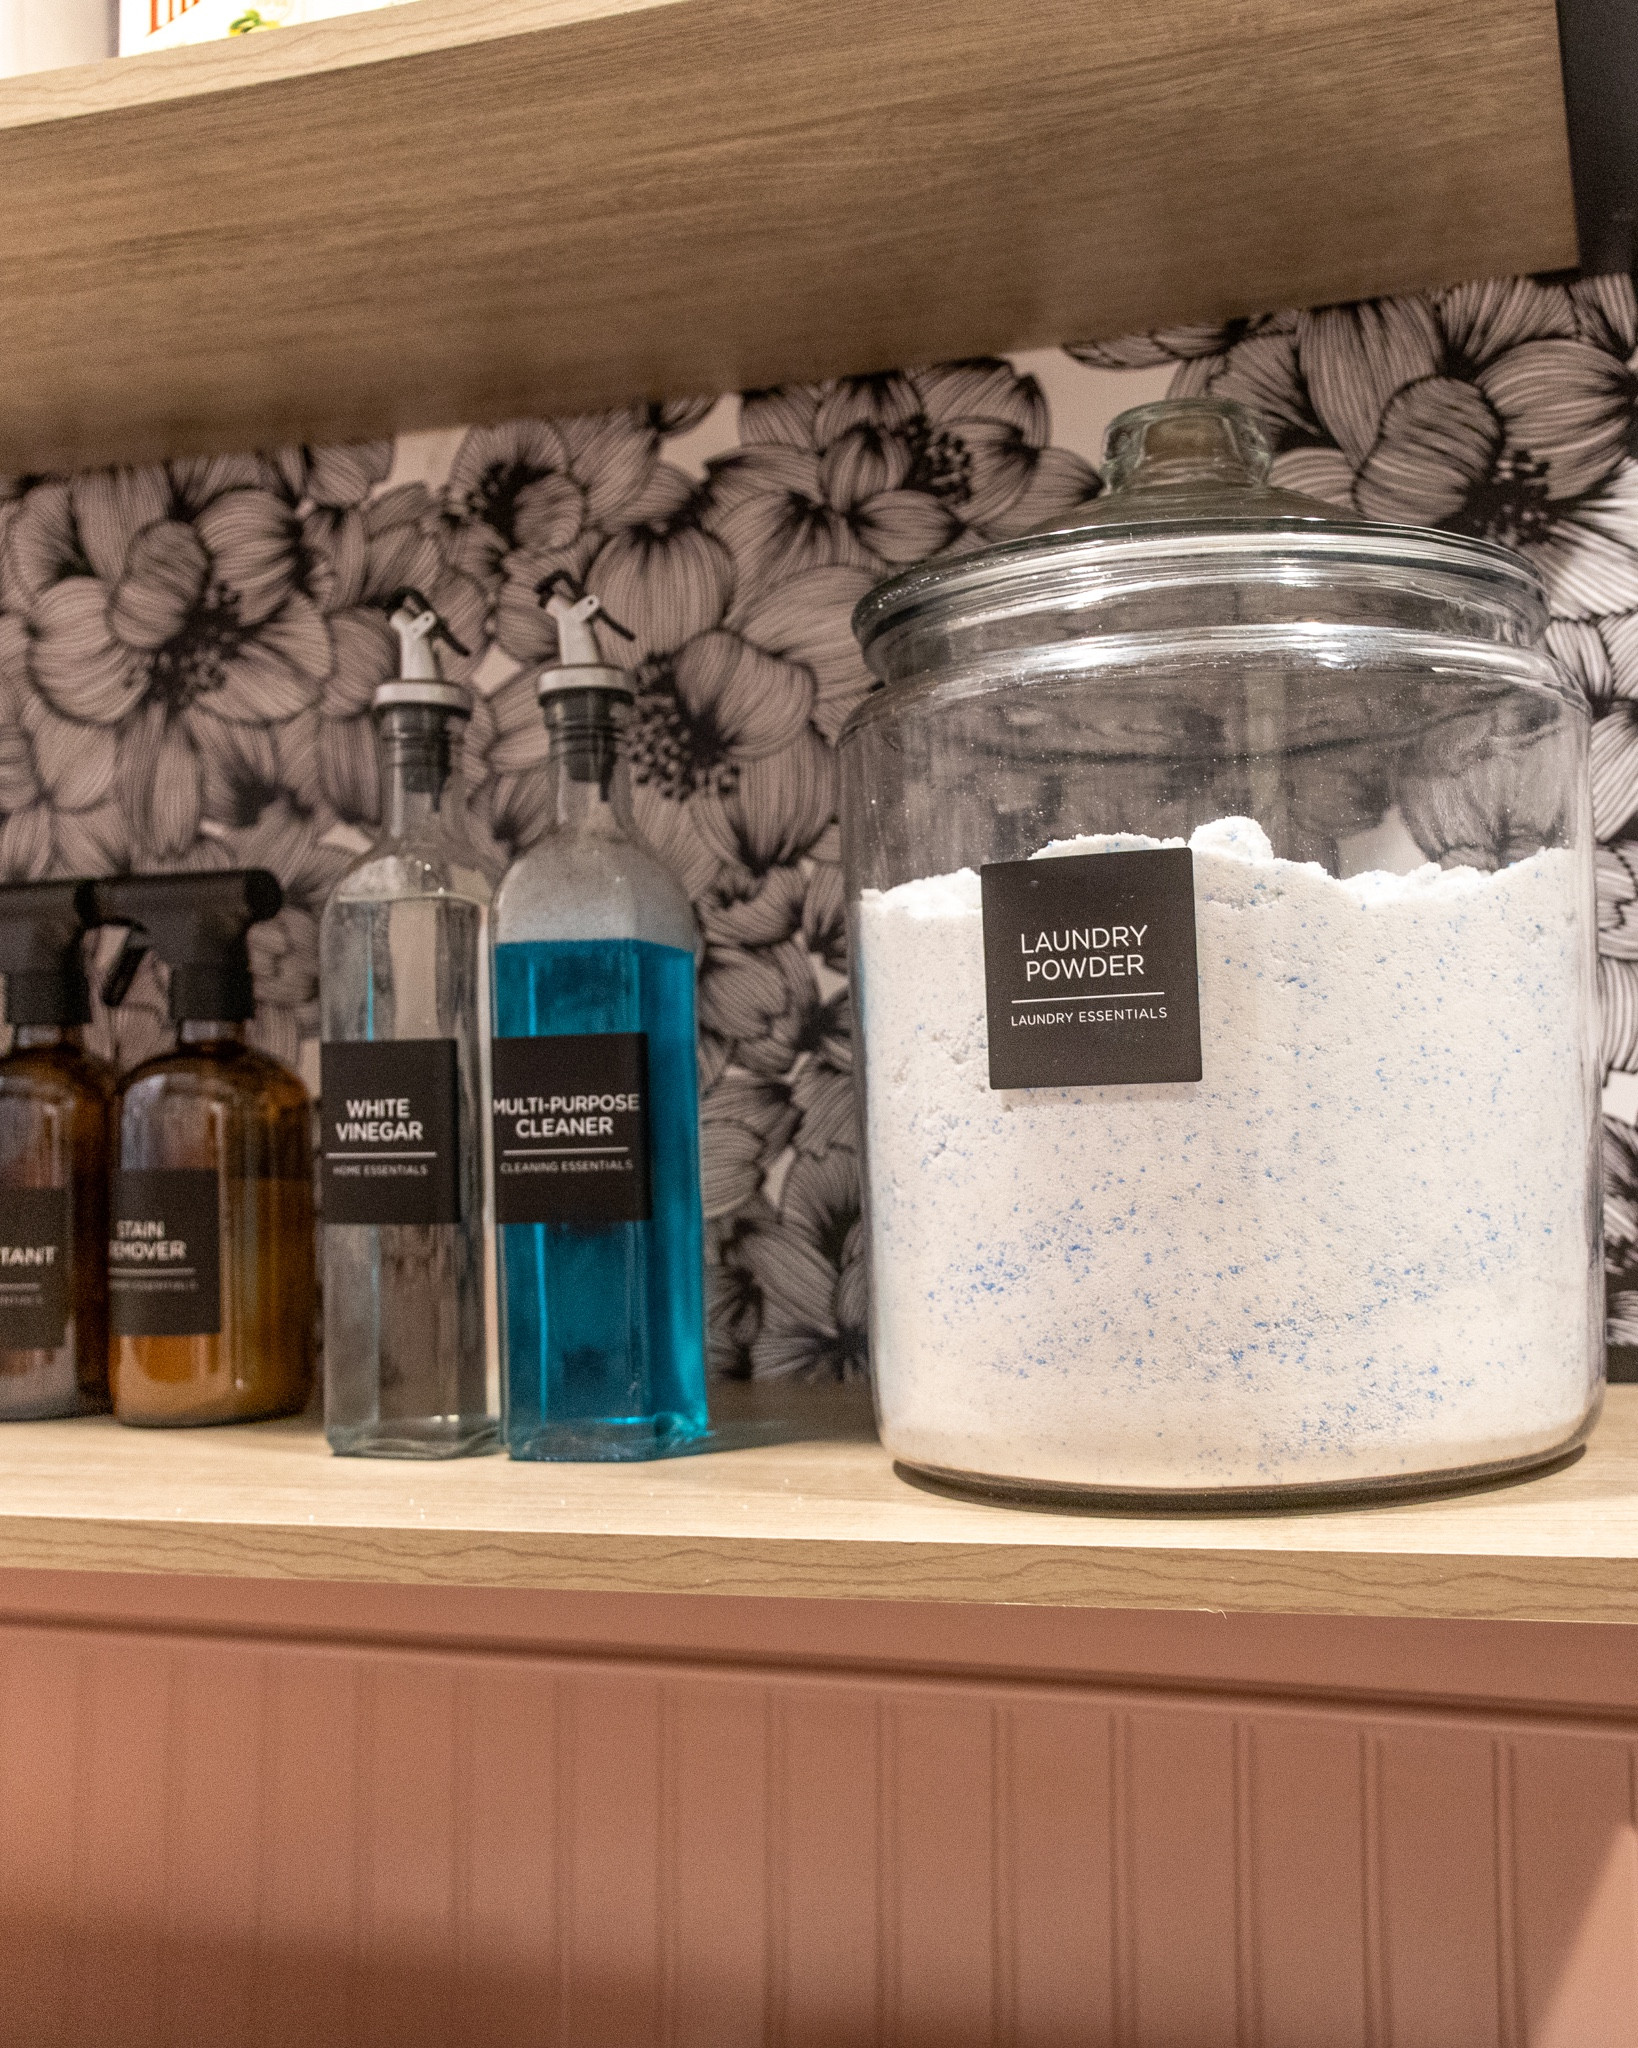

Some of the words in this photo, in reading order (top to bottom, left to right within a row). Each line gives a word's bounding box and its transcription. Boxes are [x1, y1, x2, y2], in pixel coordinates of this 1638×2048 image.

[1020, 924, 1148, 954] LAUNDRY
[1026, 954, 1144, 982] POWDER
[1011, 1012, 1074, 1027] LAUNDRY
[1079, 1006, 1168, 1023] ESSENTIALS
[345, 1098, 411, 1119] WHITE
[493, 1093, 640, 1116] MULTI-PURPOSE
[335, 1120, 424, 1142] VINEGAR
[515, 1116, 614, 1139] CLEANER
[363, 1163, 428, 1177] ESSENTIALS
[500, 1160, 559, 1175] CLEANING
[561, 1158, 634, 1174] ESSENTIALS
[116, 1219, 166, 1239] STAIN
